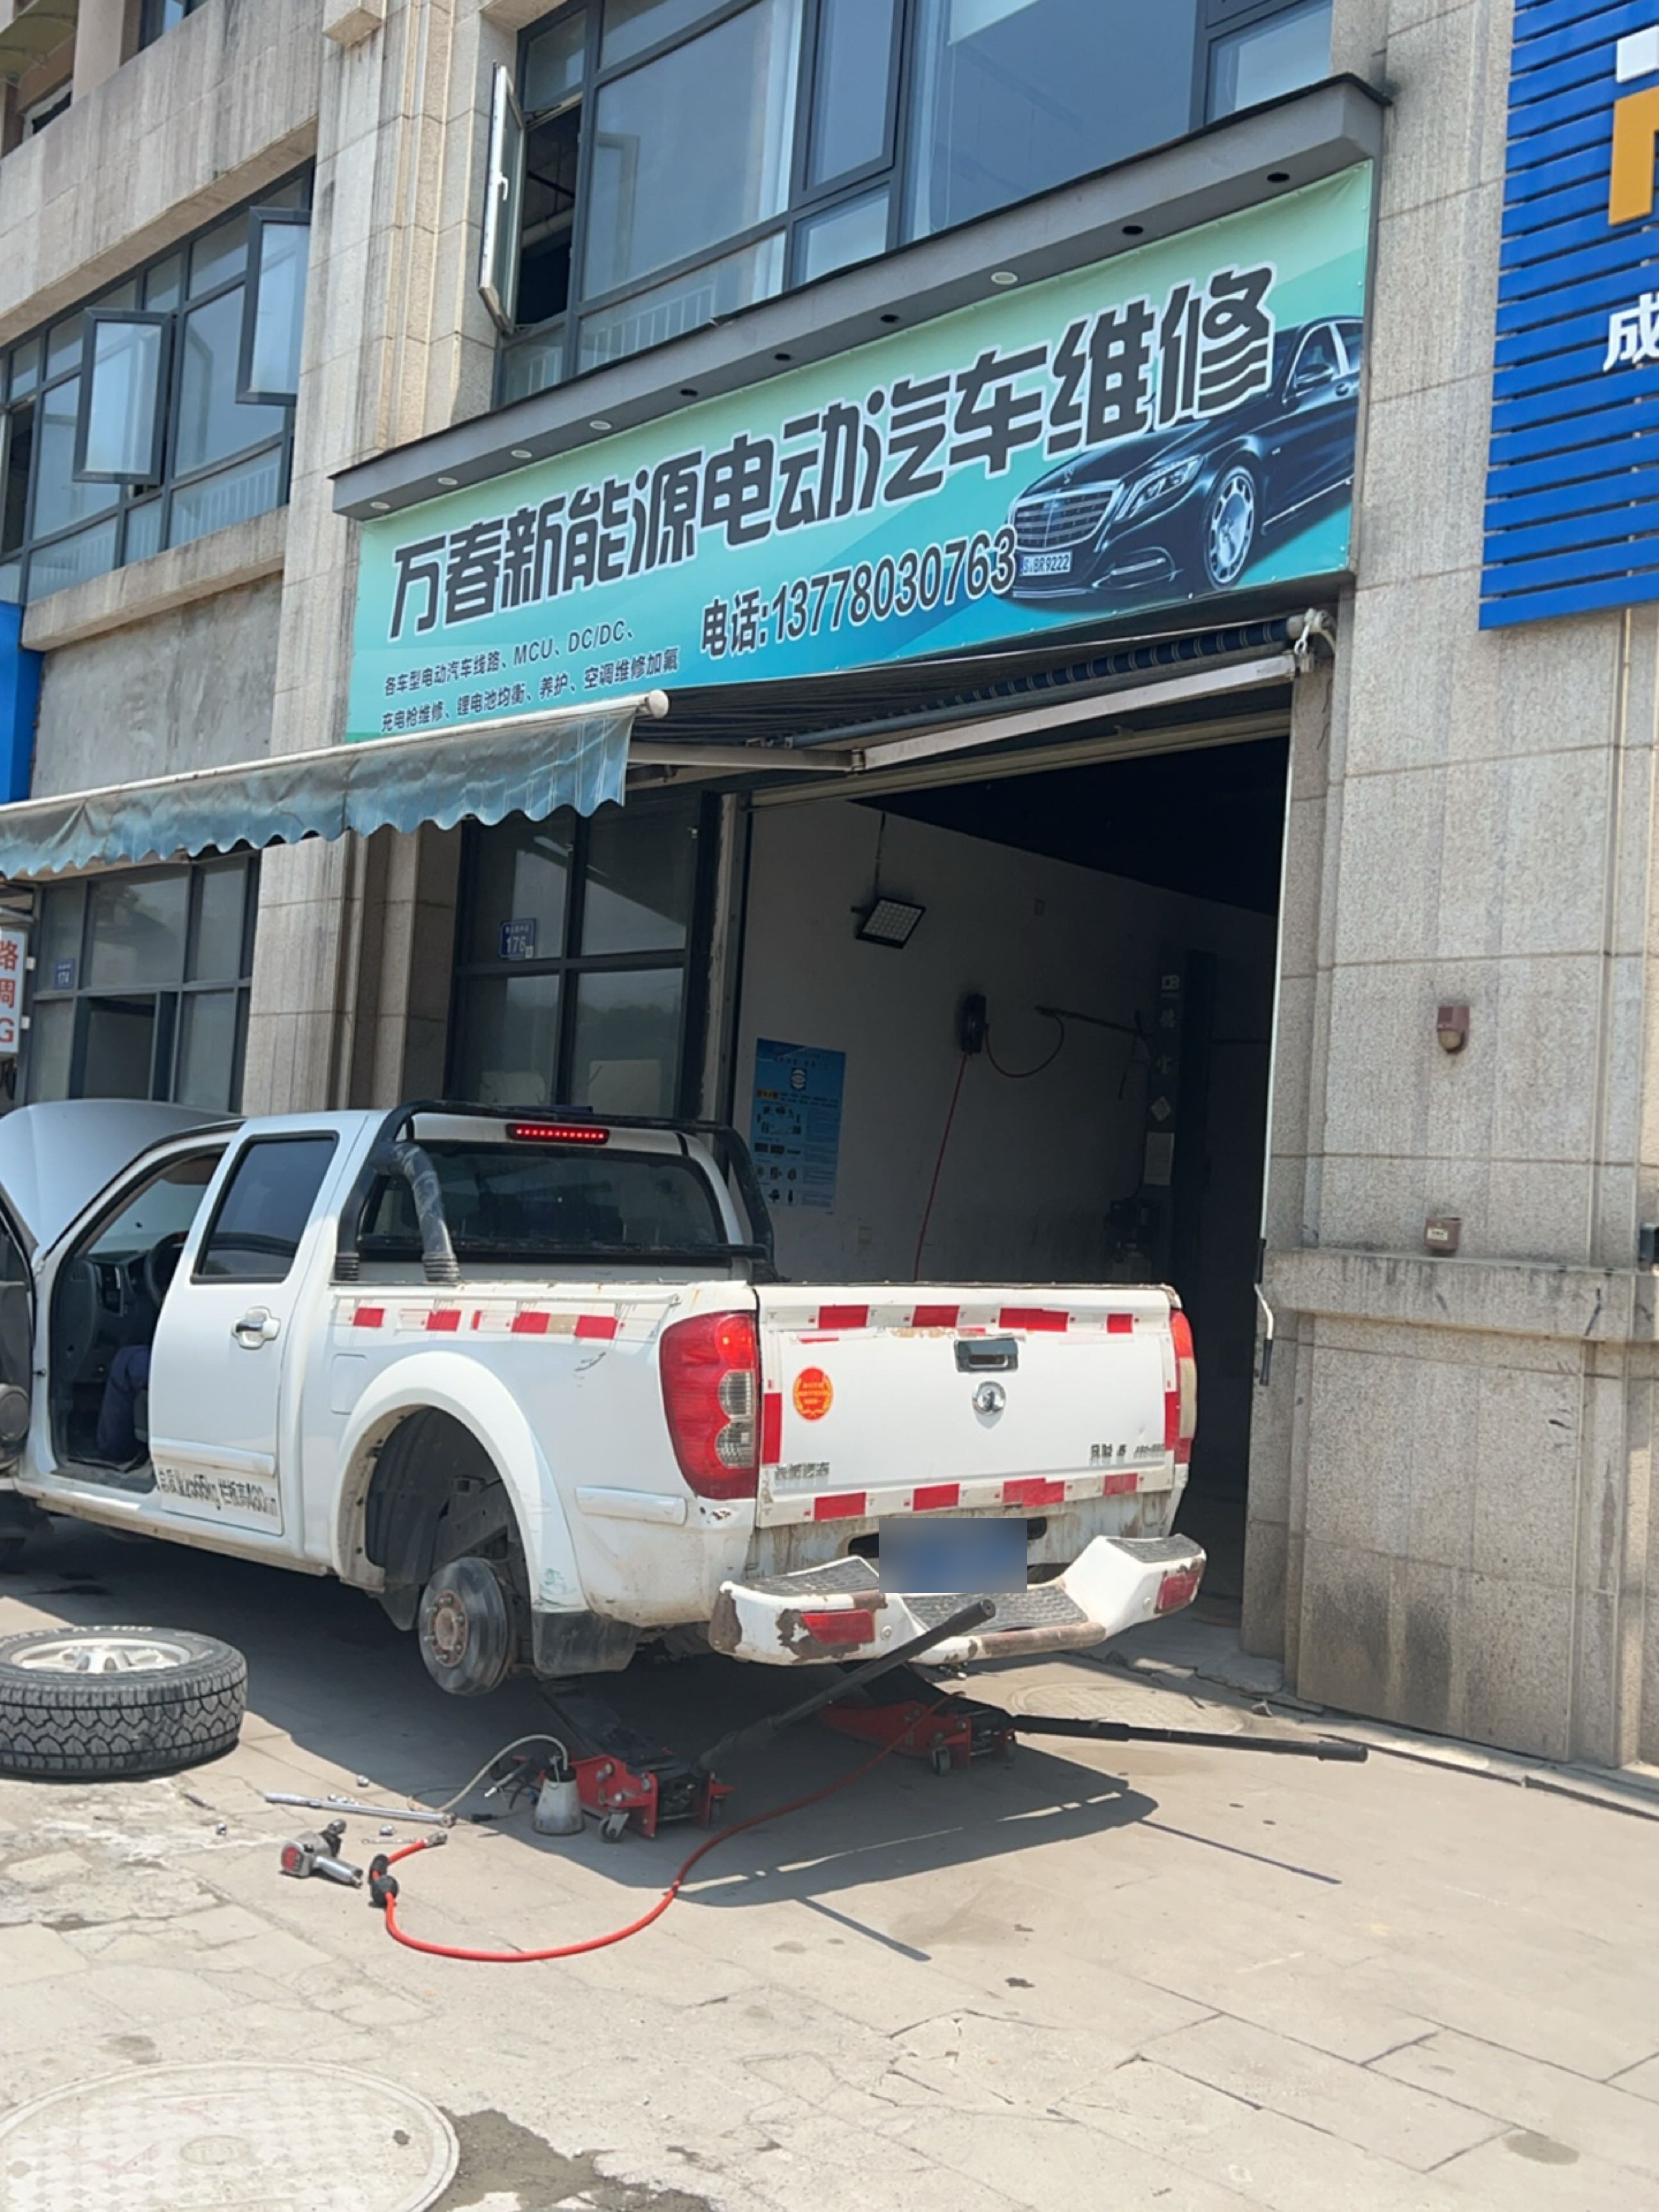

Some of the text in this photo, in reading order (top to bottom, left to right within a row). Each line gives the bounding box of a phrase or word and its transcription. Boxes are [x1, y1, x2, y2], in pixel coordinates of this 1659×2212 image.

[388, 269, 1274, 639] 万春新能源电动汽车维修
